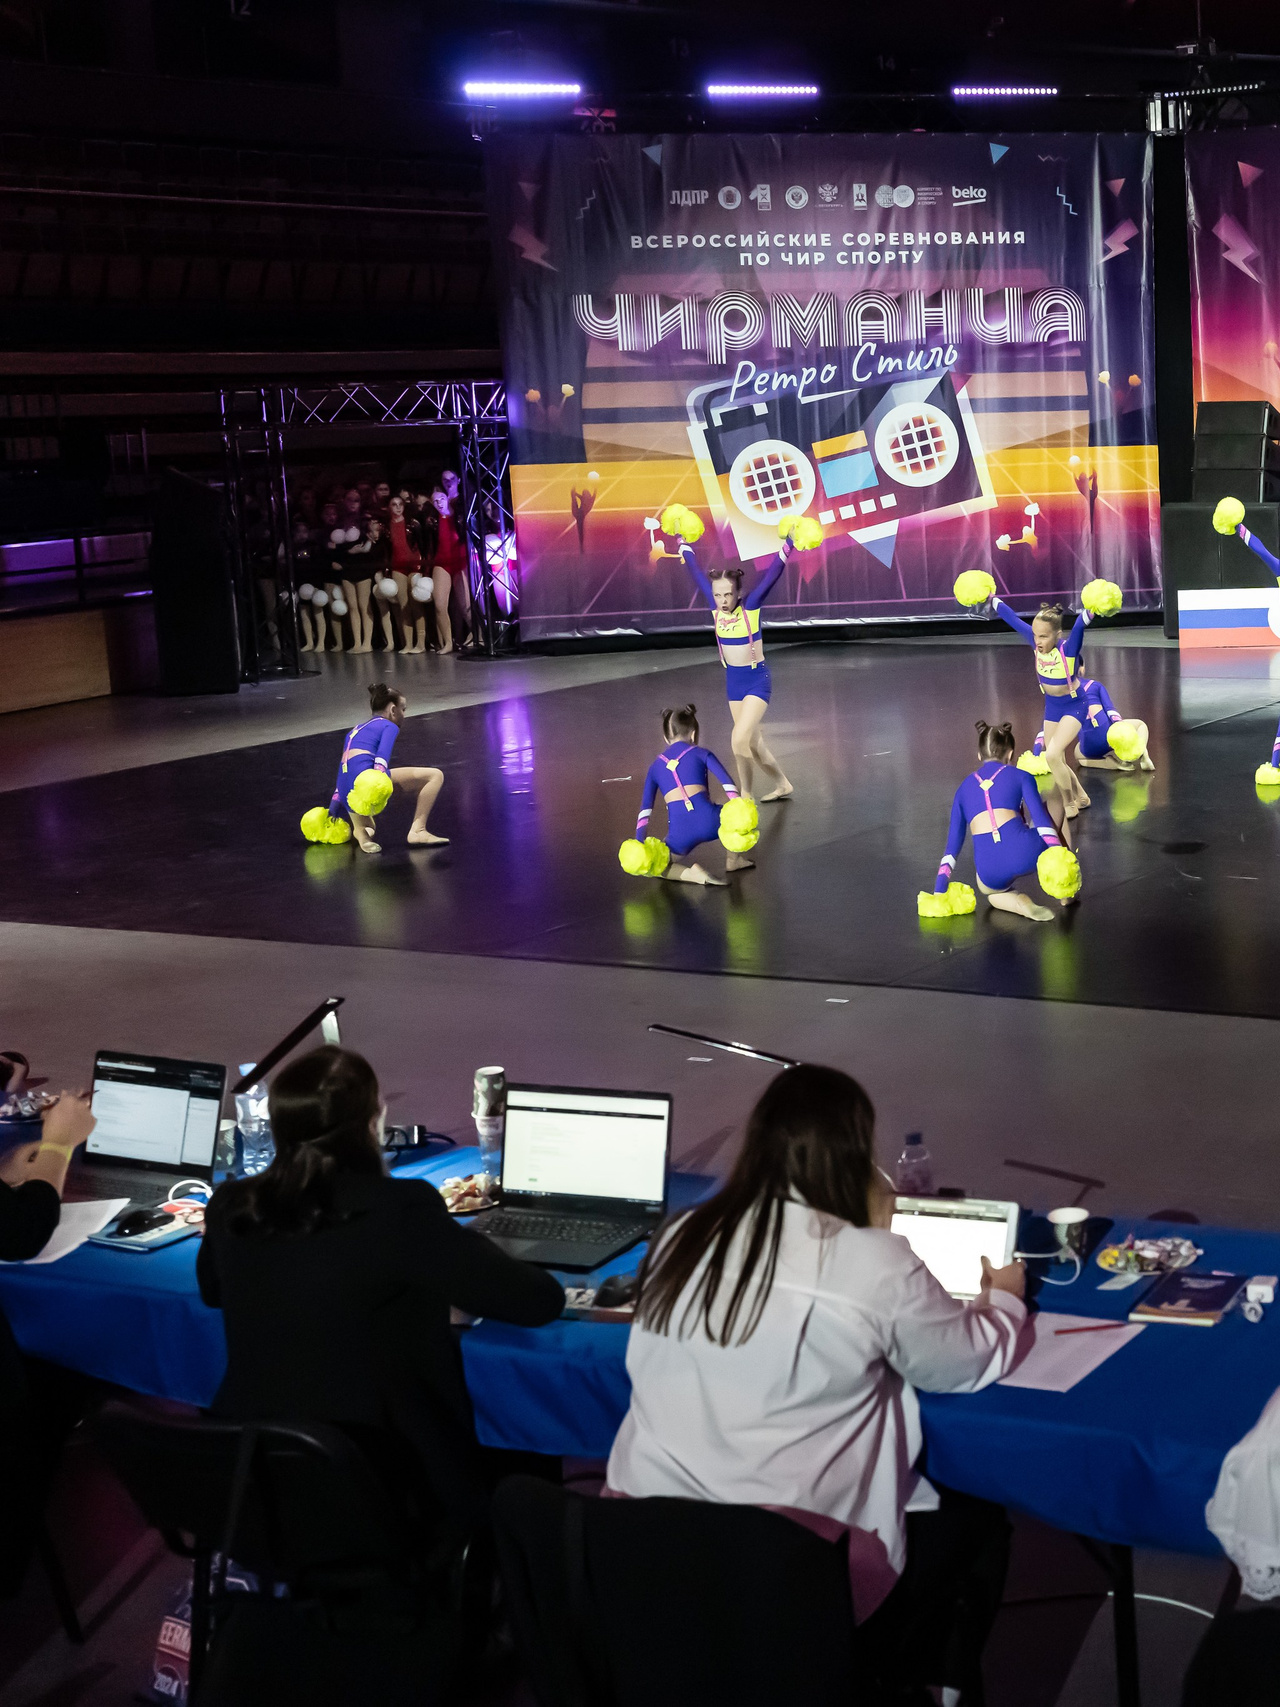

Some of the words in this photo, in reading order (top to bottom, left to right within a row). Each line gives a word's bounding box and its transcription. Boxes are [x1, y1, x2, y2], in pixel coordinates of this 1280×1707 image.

[669, 190, 709, 207] ЛДПР
[951, 185, 987, 199] beko
[630, 230, 833, 249] ВСЕРОССИЙСКИЕ
[842, 230, 1026, 248] СОРЕВНОВАНИЯ
[739, 252, 770, 266] ПО
[780, 252, 826, 266] ЧИР
[836, 250, 925, 266] СПОРТУ
[727, 359, 838, 405] Ретро
[851, 342, 959, 385] Стиль
